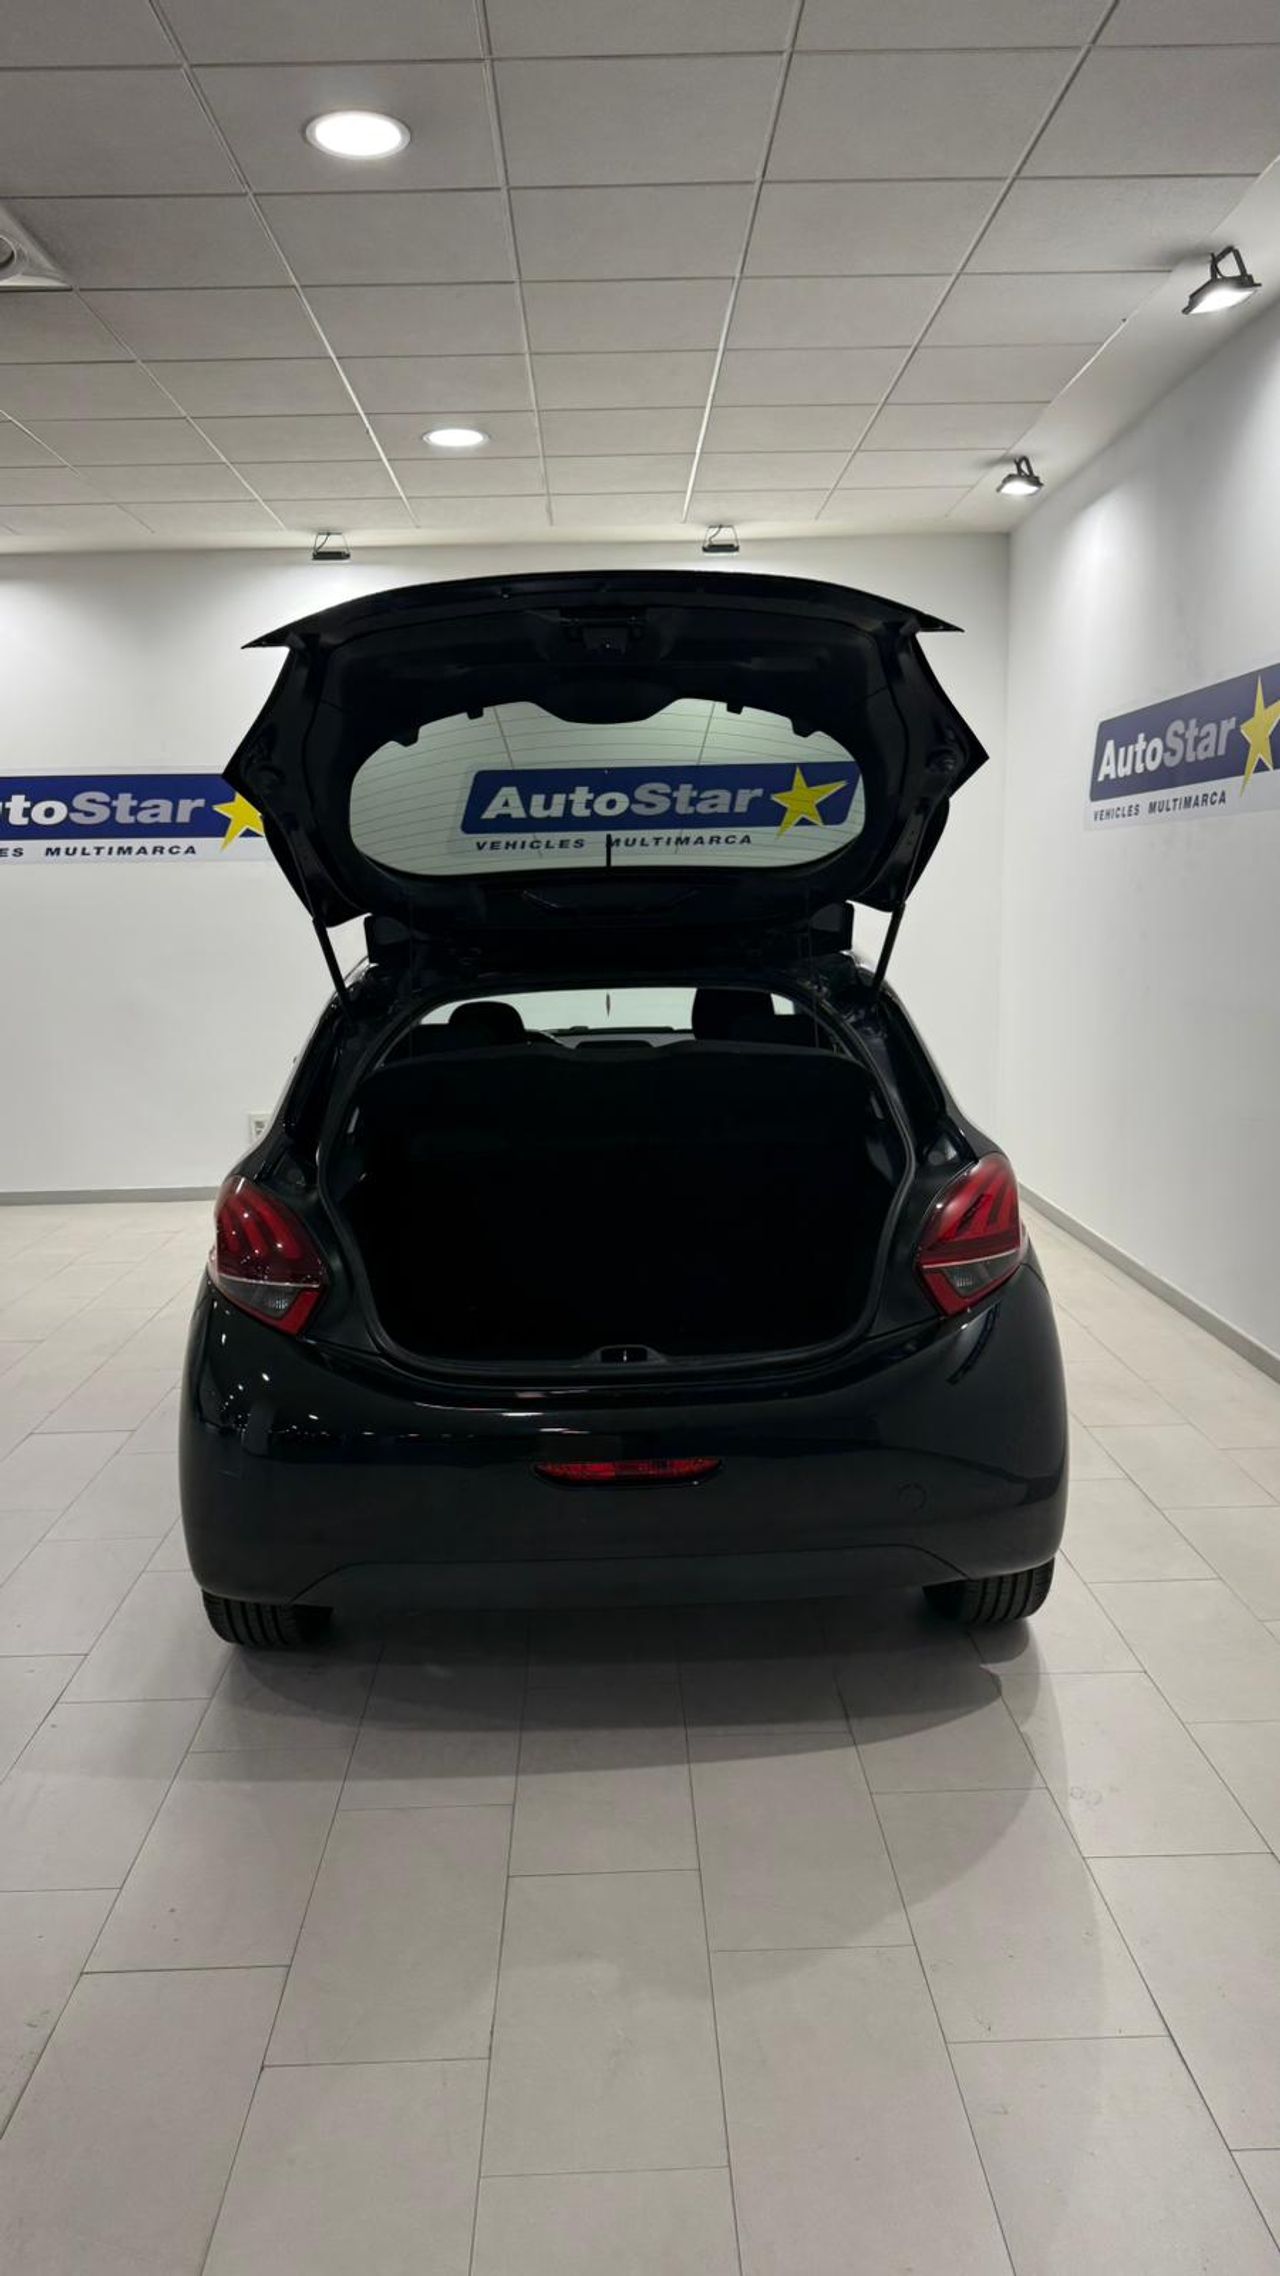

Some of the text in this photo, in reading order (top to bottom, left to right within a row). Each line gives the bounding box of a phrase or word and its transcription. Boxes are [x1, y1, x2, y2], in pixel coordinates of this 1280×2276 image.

[1098, 717, 1236, 782] AutoStar
[0, 791, 205, 826] toStar
[480, 782, 763, 819] AutoStar
[1094, 790, 1226, 821] VEHICLES MULTIMARCA
[45, 845, 196, 857] MULTIMARCA
[476, 834, 752, 851] VEHICLES MULTIMARCA
